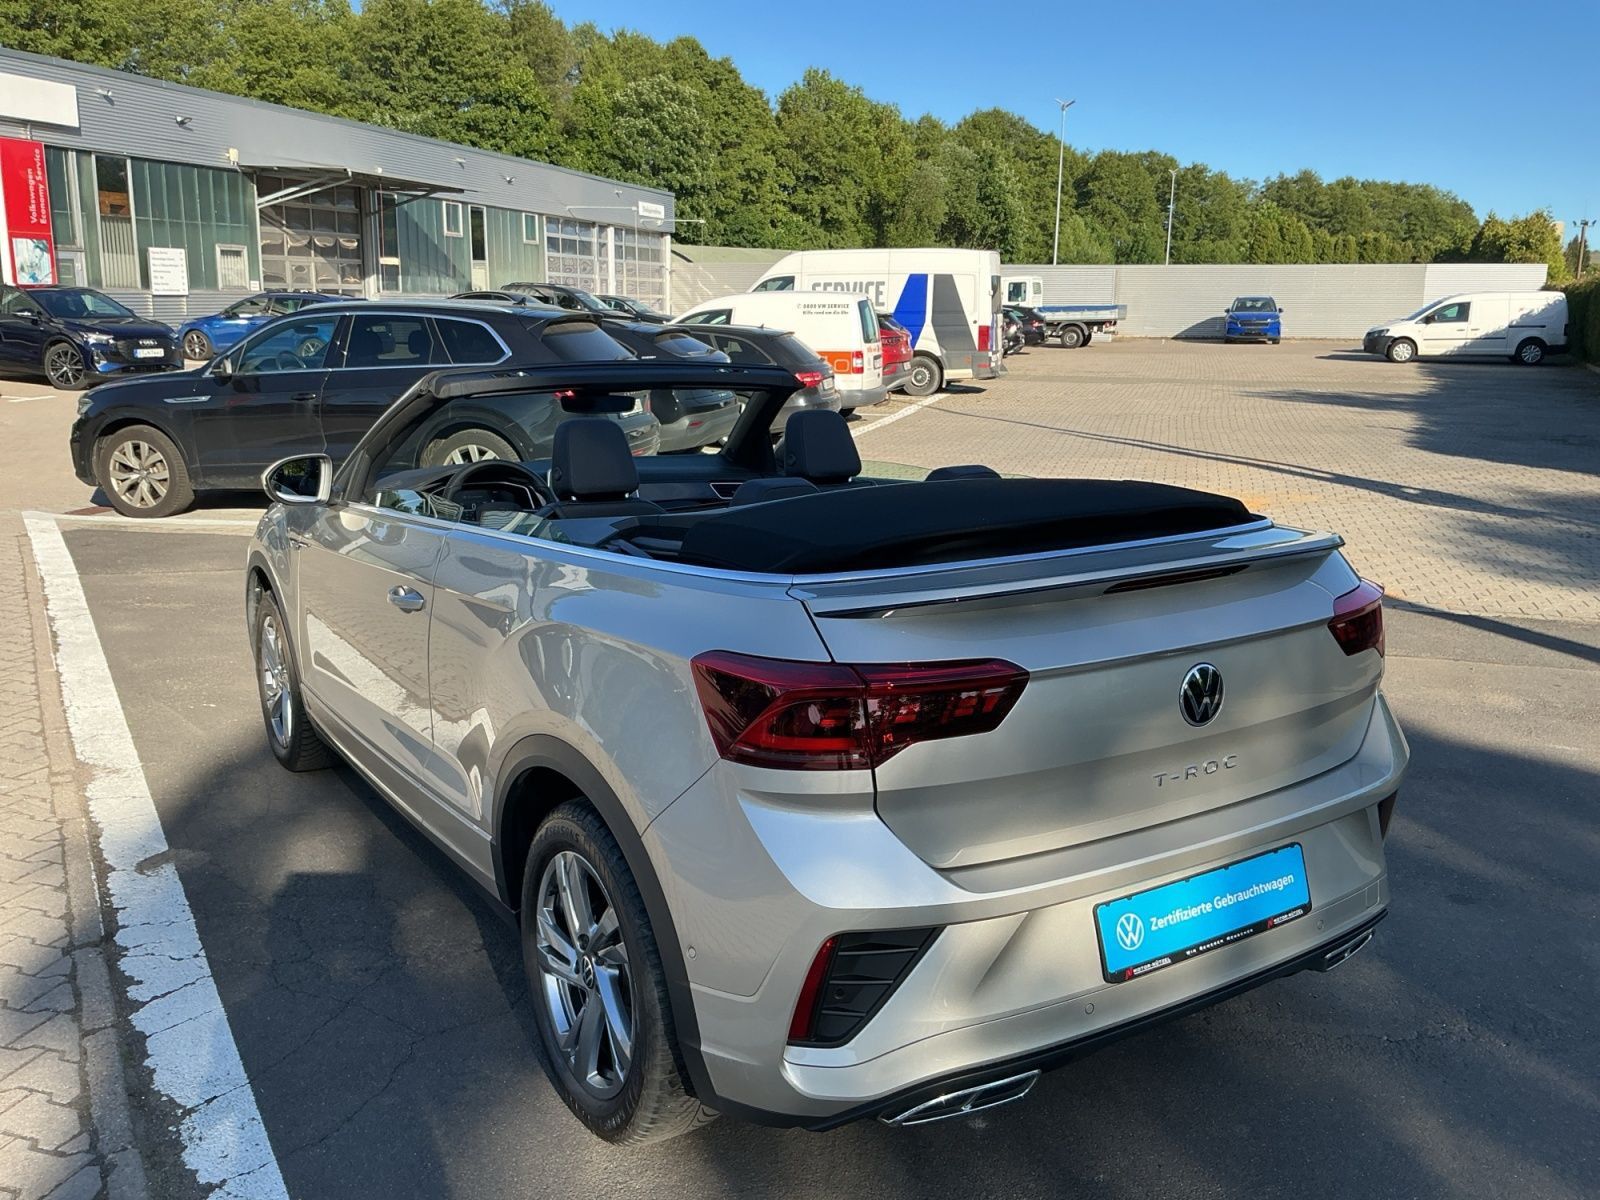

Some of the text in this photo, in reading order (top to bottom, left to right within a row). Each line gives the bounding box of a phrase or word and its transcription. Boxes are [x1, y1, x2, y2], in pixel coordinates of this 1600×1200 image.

[27, 168, 38, 224] Volkswagen
[34, 148, 47, 225] Economy Service
[1153, 754, 1238, 787] T-ROC
[1150, 874, 1295, 931] Zertifizierte Gebrauchtwagen
[1116, 913, 1145, 951] VW
